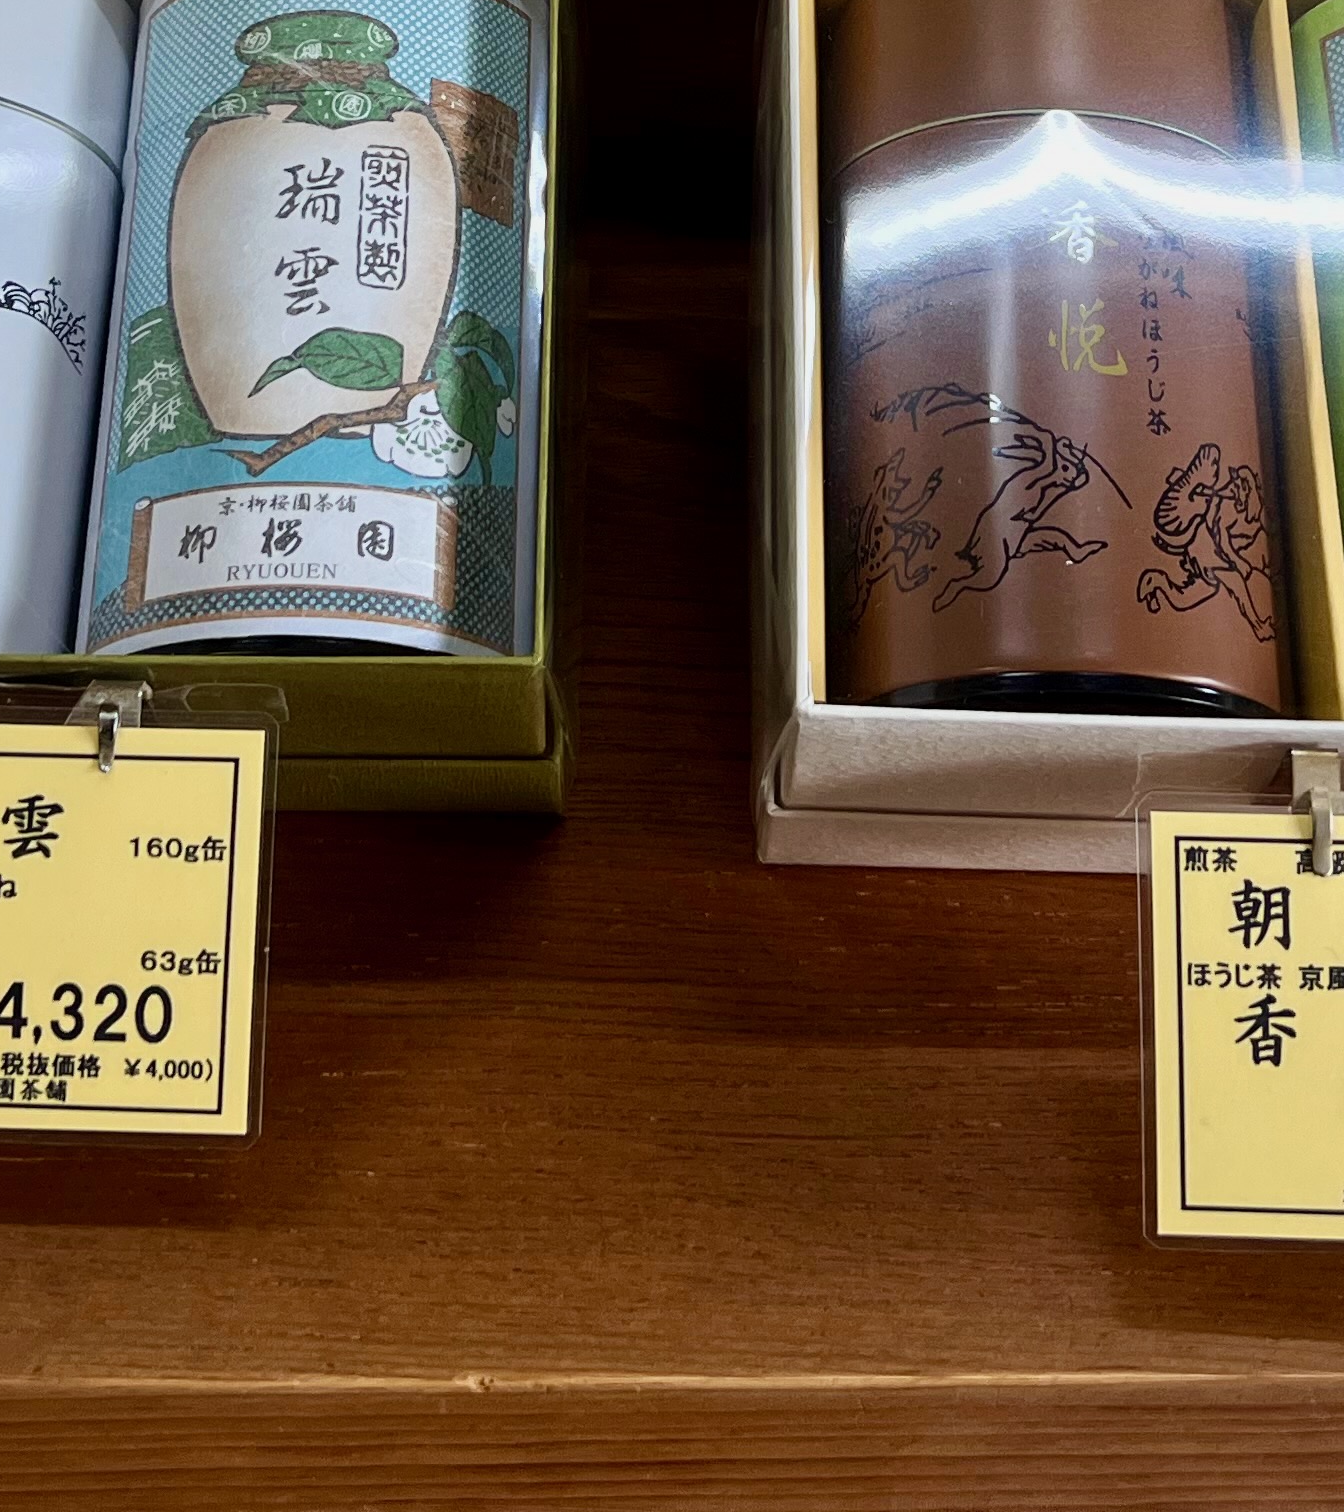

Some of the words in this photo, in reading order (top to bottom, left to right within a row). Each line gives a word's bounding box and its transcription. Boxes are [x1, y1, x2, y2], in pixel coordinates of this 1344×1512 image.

[274, 157, 346, 317] 瑞雲
[1048, 200, 1129, 377] 香悦
[225, 561, 338, 582] RYUOUEN
[129, 836, 228, 864] 160g缶
[1183, 846, 1238, 874] 煎茶
[140, 949, 223, 977] 63g缶
[1186, 962, 1283, 990] ほうじ茶
[124, 1057, 215, 1082] ¥4,000)
